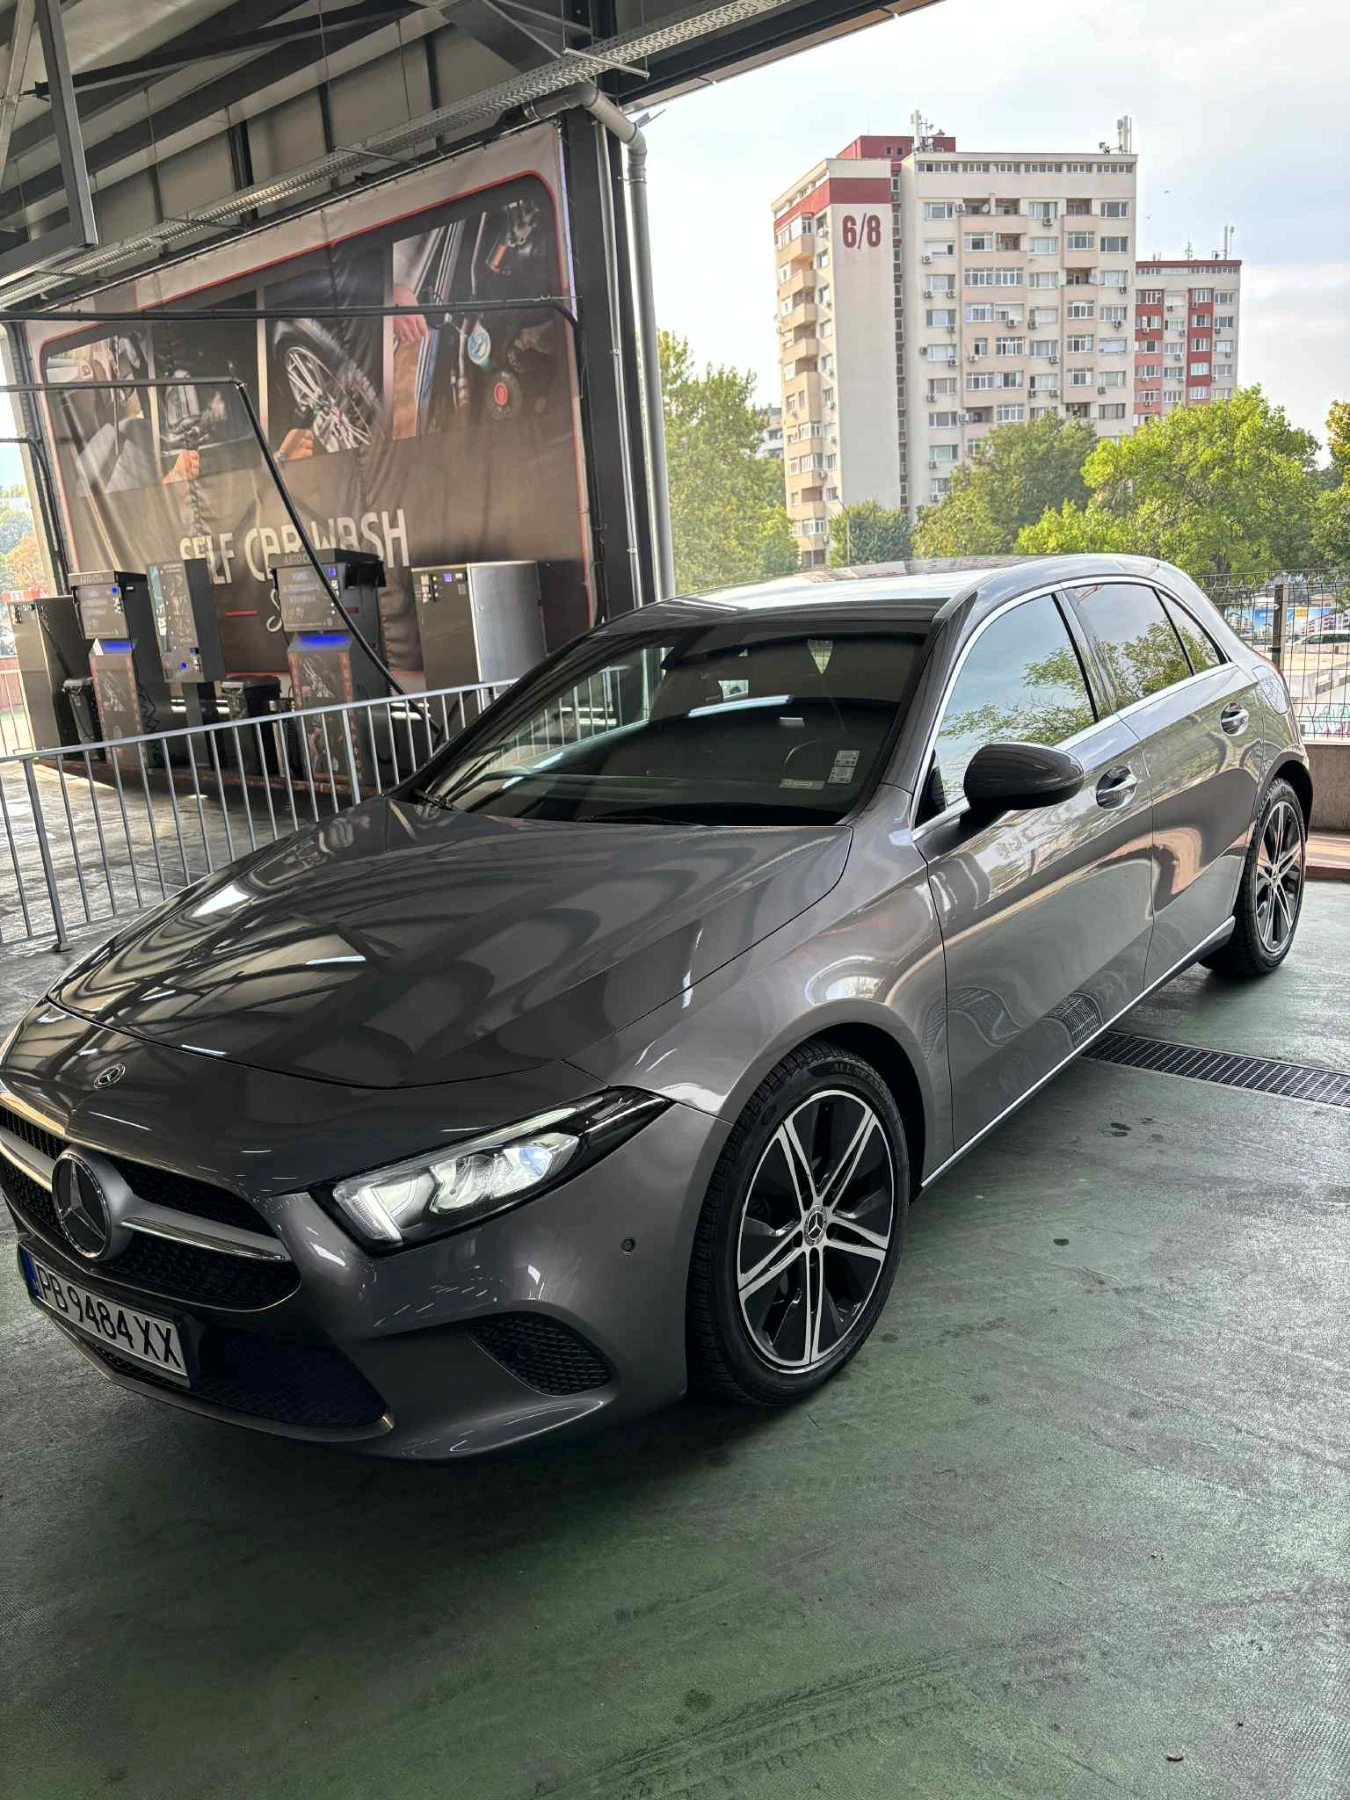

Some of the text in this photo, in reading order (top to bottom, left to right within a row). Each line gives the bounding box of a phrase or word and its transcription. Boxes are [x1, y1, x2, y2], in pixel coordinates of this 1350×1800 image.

[842, 212, 881, 250] 6/8
[311, 509, 409, 568] WASH
[67, 1284, 135, 1350] 9484
